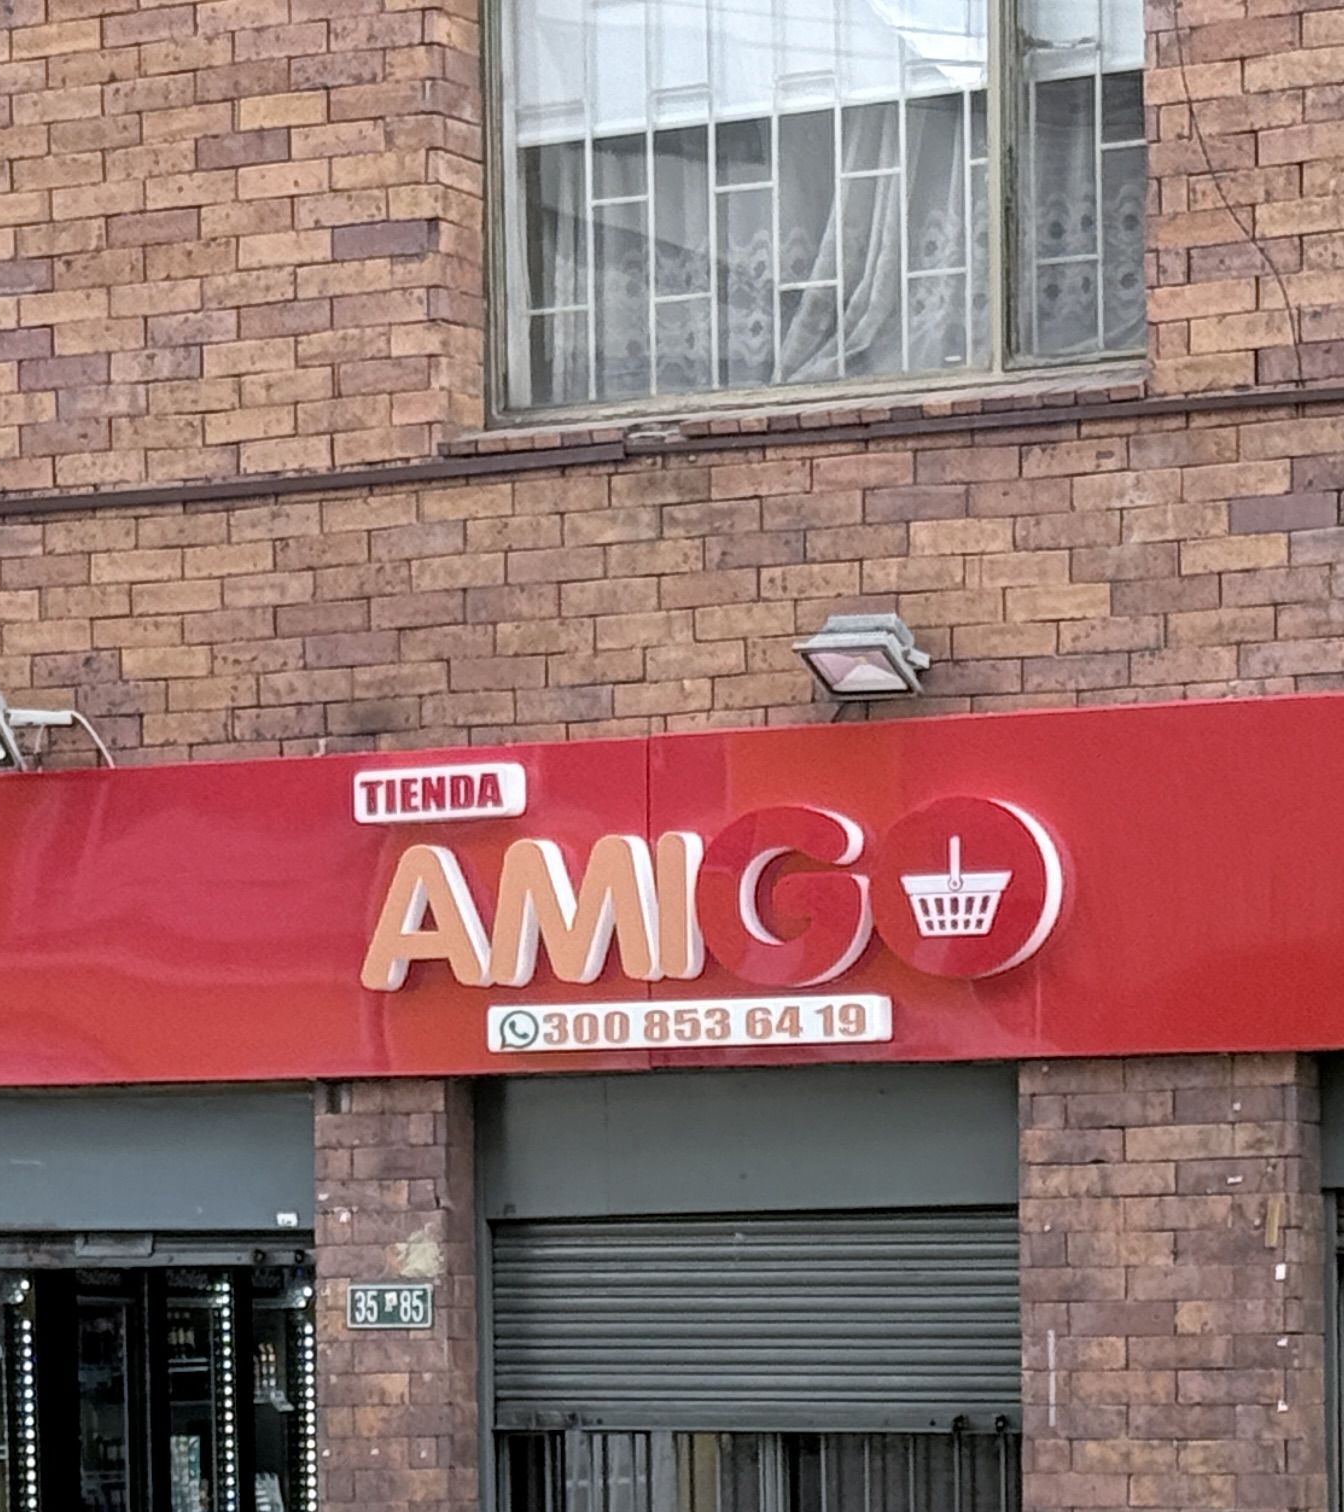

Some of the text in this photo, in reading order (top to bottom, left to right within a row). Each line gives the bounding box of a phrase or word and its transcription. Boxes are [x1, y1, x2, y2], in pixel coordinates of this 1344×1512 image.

[360, 772, 503, 816] TIENDA
[360, 797, 1062, 991] AMIGO
[543, 1003, 868, 1046] 300 853 64 19
[355, 1290, 378, 1322] 35
[399, 1290, 424, 1322] 85
